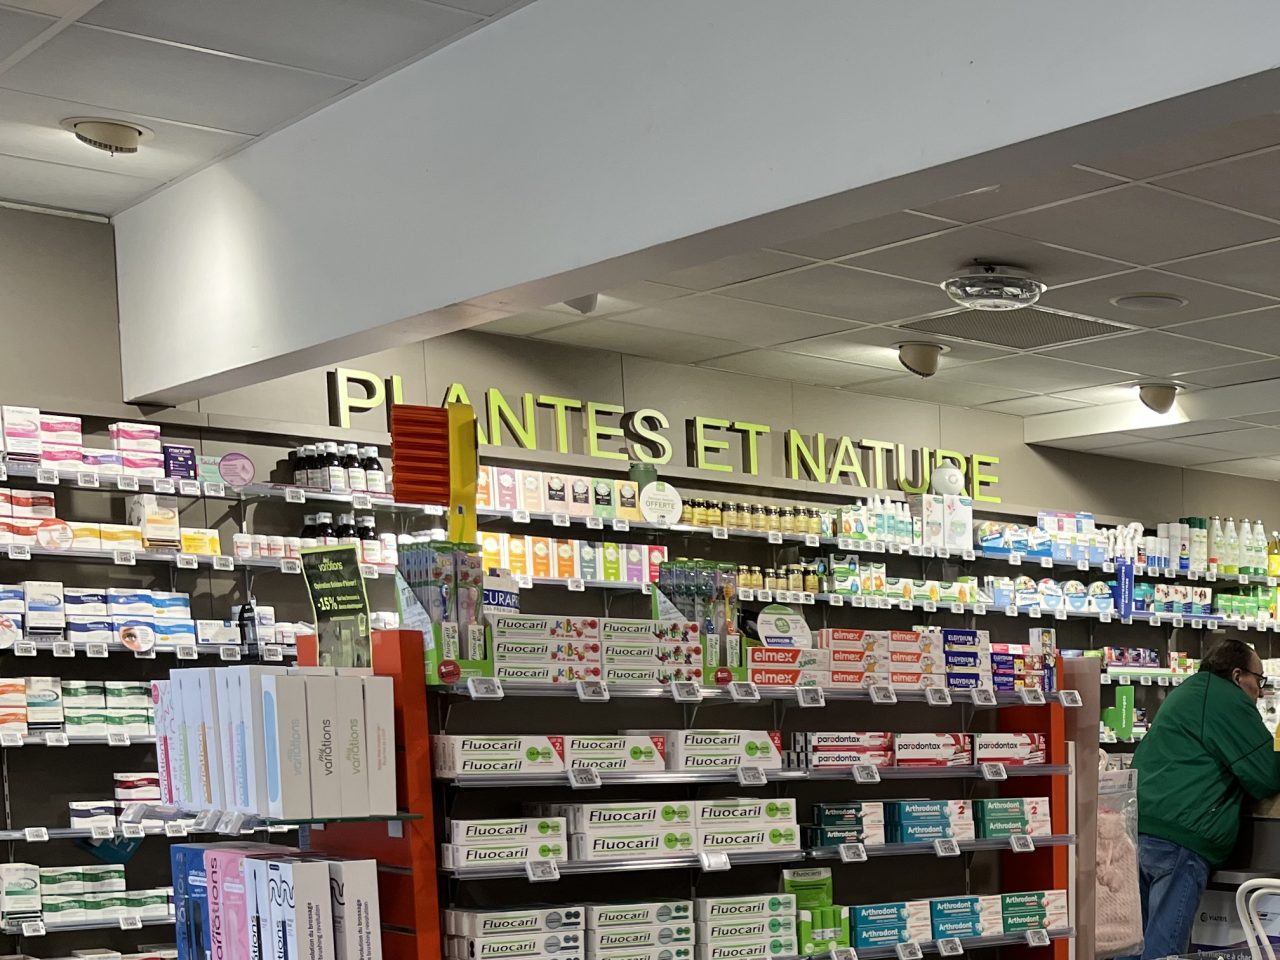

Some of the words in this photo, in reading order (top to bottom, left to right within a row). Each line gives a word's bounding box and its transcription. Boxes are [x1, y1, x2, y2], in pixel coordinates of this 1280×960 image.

[694, 415, 770, 475] ET
[645, 501, 675, 511] OFFERTE
[497, 619, 547, 631] Fluocaril
[603, 623, 651, 634] Fluocaril
[832, 631, 861, 641] elmex
[892, 632, 918, 642] elmex
[497, 643, 548, 655] Fluocaril
[605, 646, 654, 657] Fluocaril
[754, 650, 792, 664] elmex
[832, 652, 861, 662] elmex
[892, 652, 918, 662] elmex
[498, 667, 549, 678] Fluocaril
[607, 669, 654, 680] Fluocaril
[833, 672, 861, 683] elmex
[755, 673, 793, 684] elmex
[892, 673, 918, 683] elmex
[571, 740, 626, 749] Fluocaril
[817, 735, 860, 744] parodontax
[324, 719, 333, 776] variations
[462, 740, 522, 750] Fluocaril
[898, 741, 941, 751] parodontax
[978, 741, 1018, 751] parodontax
[818, 755, 861, 763] parodontax
[462, 761, 522, 770] Fluocaril
[905, 803, 940, 813] Arthrodont
[958, 805, 965, 815] 2
[987, 800, 1020, 810] Arthrodont
[1030, 805, 1038, 815] 2
[825, 807, 856, 816] Arthrodont
[907, 825, 943, 834] Arthrodont
[989, 821, 1022, 831] Arthrodont
[827, 830, 857, 839] Arthrodont
[937, 900, 971, 911] Arthrodont
[861, 906, 897, 916] Arthrodont
[862, 928, 898, 938] Arthrodont
